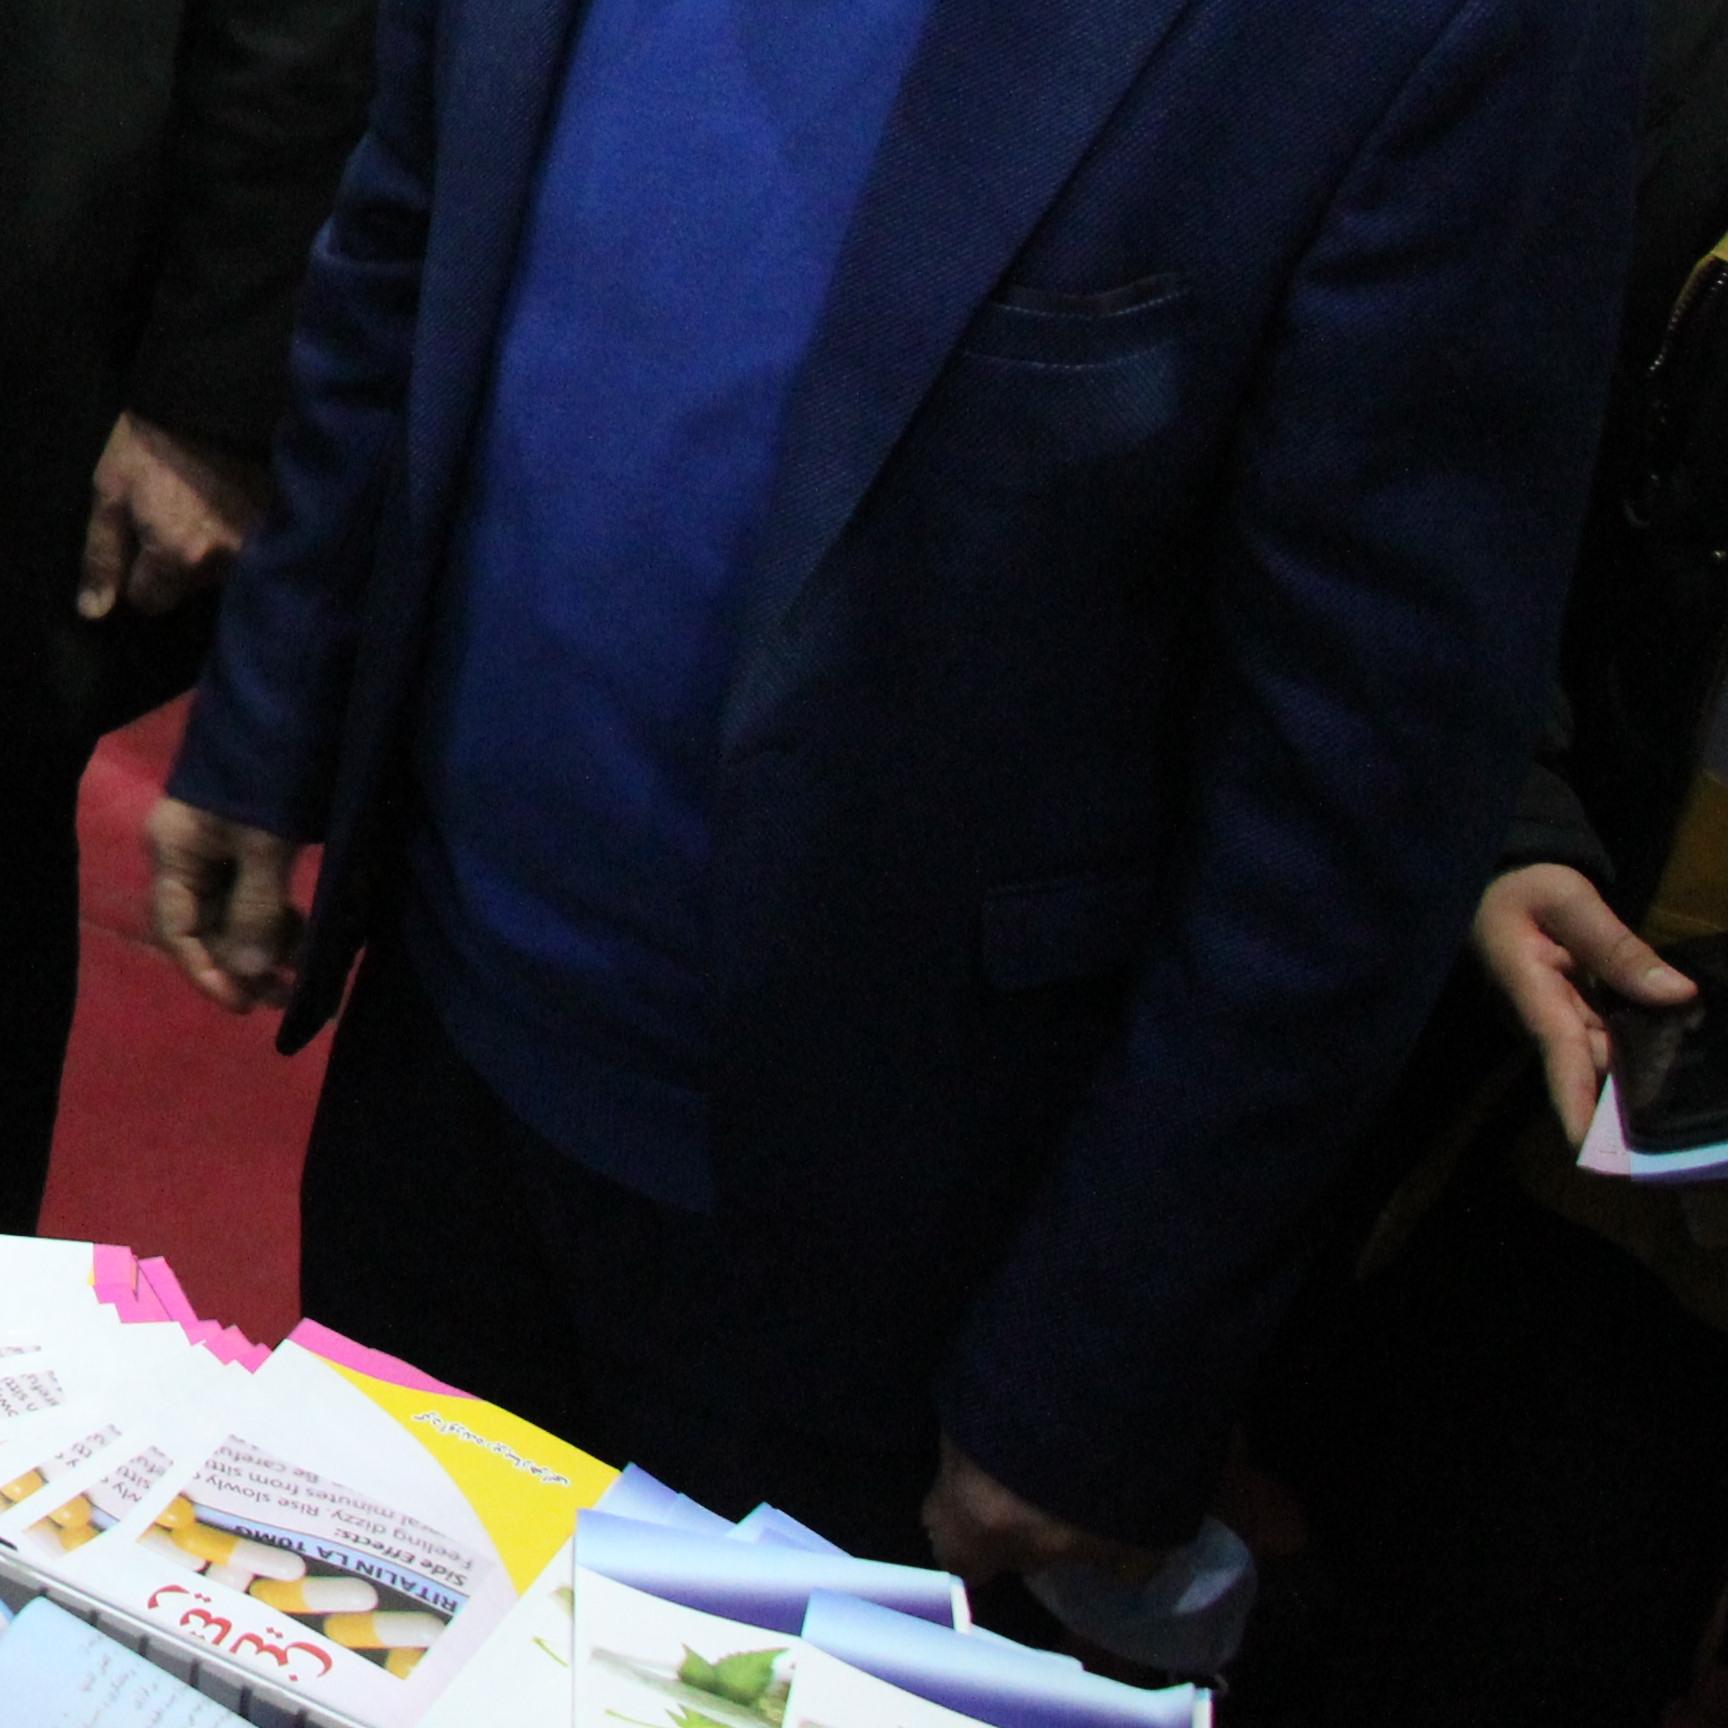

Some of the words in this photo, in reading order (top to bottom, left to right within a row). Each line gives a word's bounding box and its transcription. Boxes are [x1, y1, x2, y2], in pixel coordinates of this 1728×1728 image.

[205, 1474, 271, 1504] slowly
[248, 1472, 300, 1495] from
[293, 1465, 320, 1484] Be
[277, 1496, 320, 1517] Rise
[305, 1486, 395, 1520] minutes
[315, 1545, 349, 1567] LA
[334, 1527, 417, 1564] Effects:
[392, 1531, 474, 1570] Feeling
[354, 1558, 459, 1613] RITALIN
[419, 1558, 469, 1587] Side
[147, 1583, 333, 1681] ریتالین
